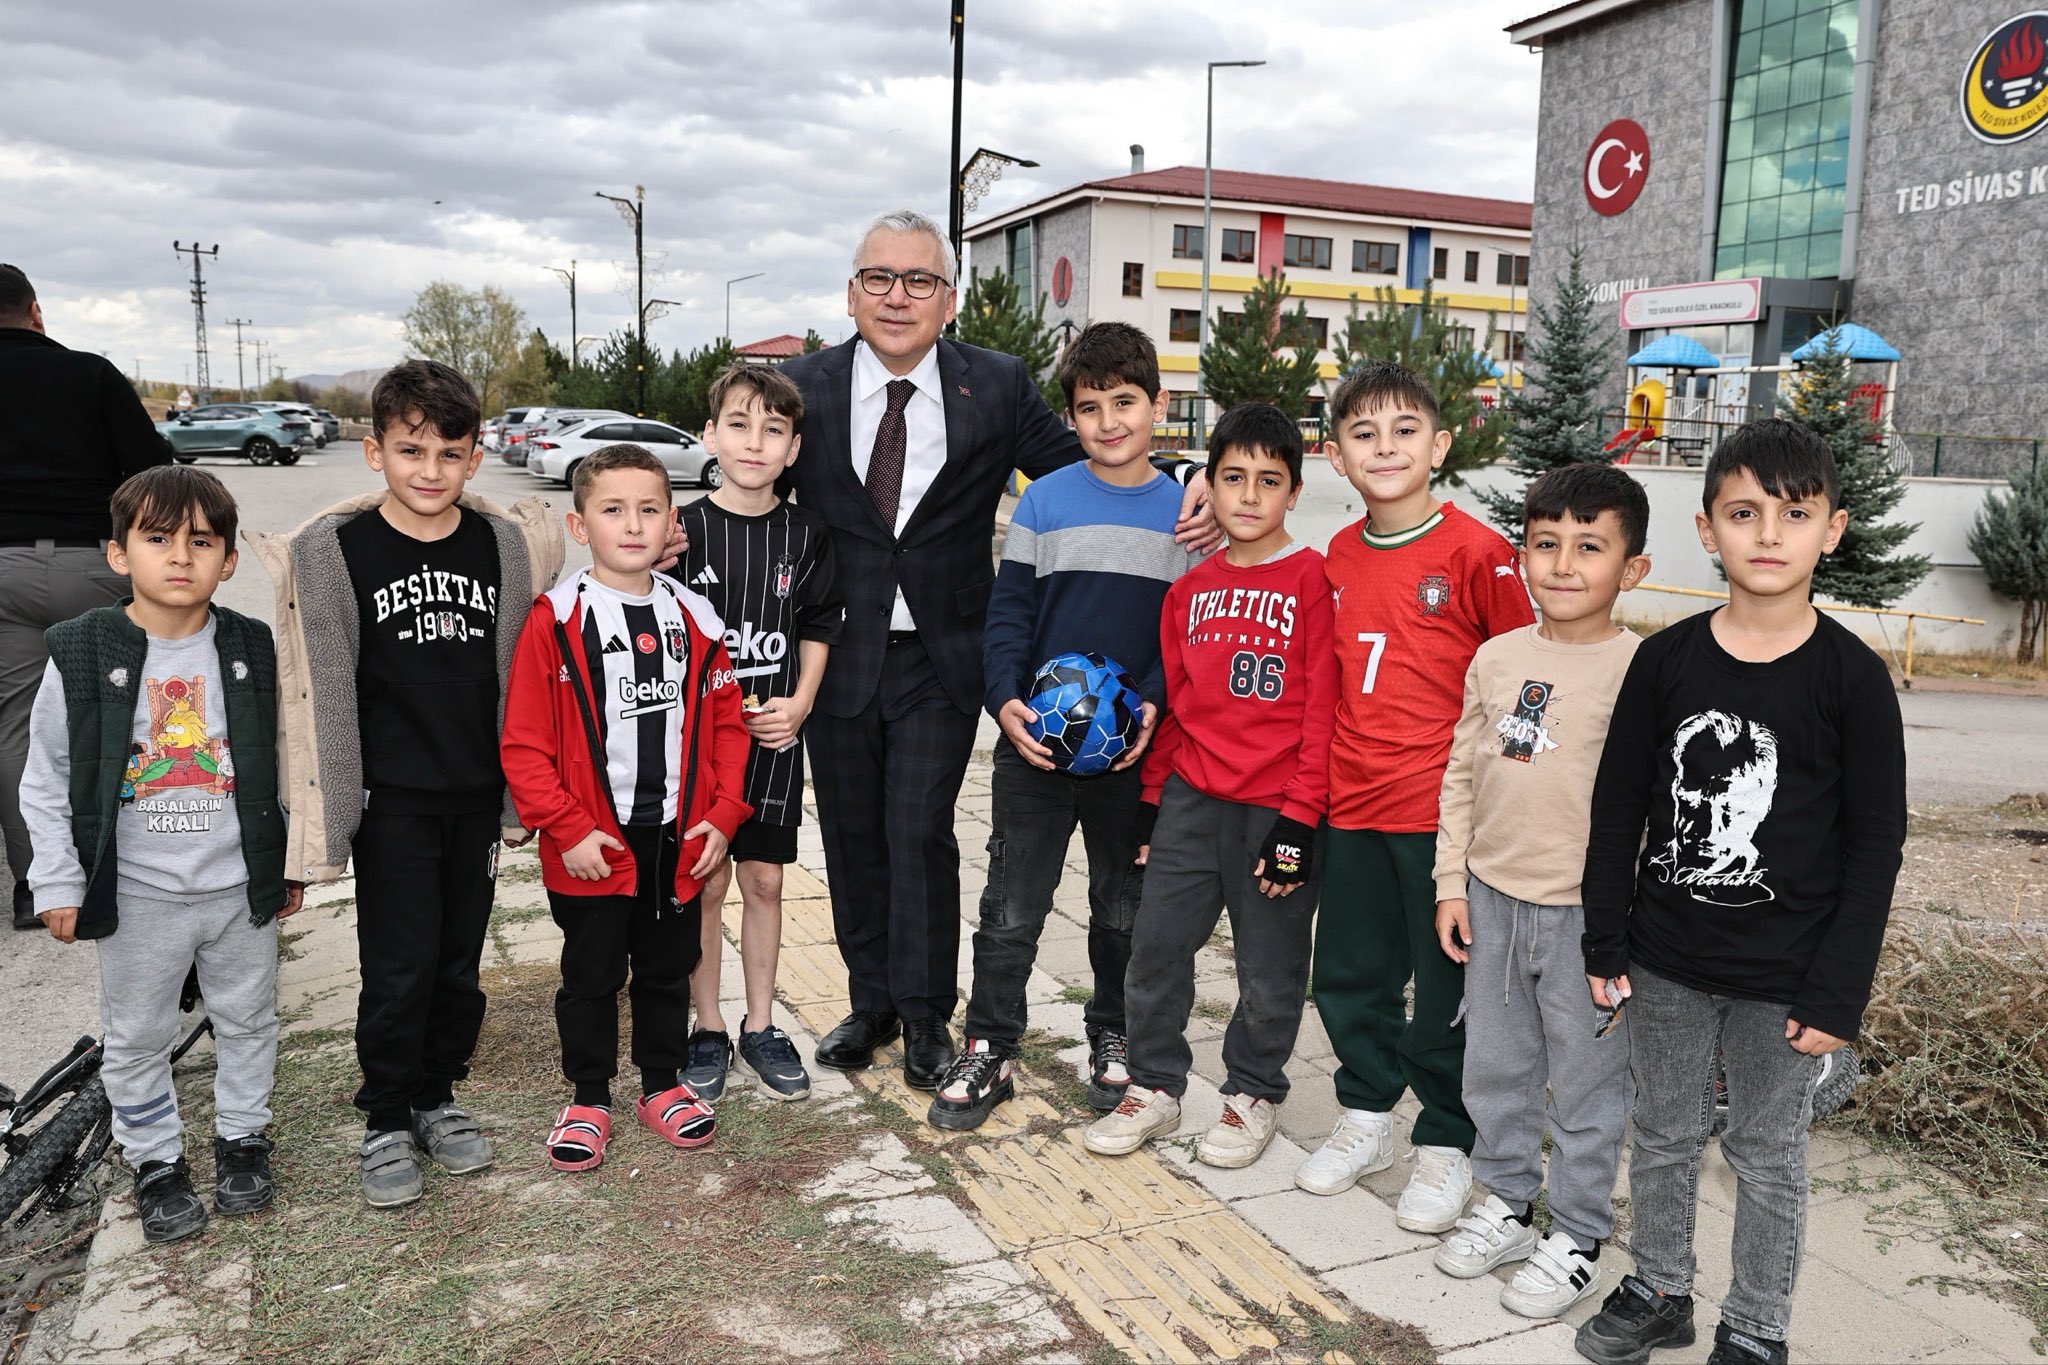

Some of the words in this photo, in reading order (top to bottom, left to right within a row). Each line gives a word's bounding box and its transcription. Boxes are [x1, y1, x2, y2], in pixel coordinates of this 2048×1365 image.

[1980, 109, 1994, 124] TED
[1895, 183, 1942, 214] TED
[1945, 170, 2024, 207] SİVAS
[373, 564, 496, 623] BEŞİKTAŞ
[1188, 588, 1297, 638] ATHLETICS
[722, 621, 787, 661] eko
[1229, 650, 1286, 702] 86
[1357, 632, 1387, 694] 7
[619, 677, 680, 703] beko
[136, 798, 224, 814] BABALARIN
[147, 813, 210, 833] KRALI
[1275, 843, 1302, 859] NYC
